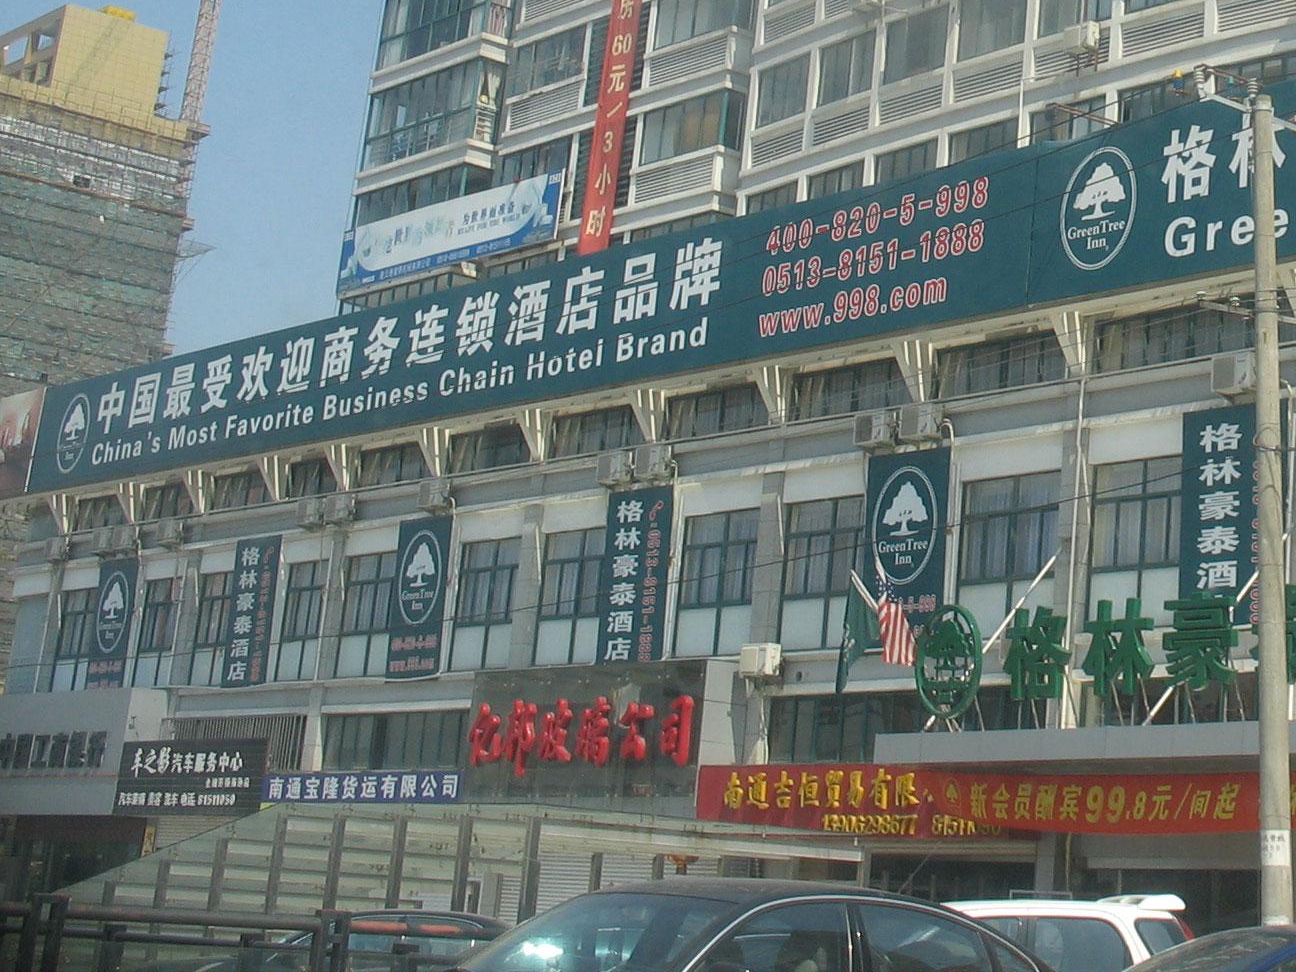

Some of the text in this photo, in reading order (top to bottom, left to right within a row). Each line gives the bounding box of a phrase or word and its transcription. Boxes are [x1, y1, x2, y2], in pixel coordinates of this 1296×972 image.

[765, 175, 989, 255] 400-820-5-998
[1066, 218, 1125, 241] GreenTree
[1086, 235, 1107, 250] Inn
[761, 218, 985, 297] 0513-8151-1888
[96, 236, 723, 435] 中国最受欢迎商务连锁酒店品牌
[758, 276, 947, 338] www.998.com
[168, 419, 222, 452] Most
[225, 404, 314, 440] Favorite
[323, 380, 429, 420] Business
[439, 359, 515, 396] Chain
[616, 317, 708, 364] Brand
[1196, 422, 1243, 599] 格林豪泰酒
[878, 537, 929, 554] GreenTree
[895, 552, 912, 565] Inn
[603, 499, 645, 662] 格林豪泰酒店
[226, 546, 261, 682] 格林豪泰酒店
[268, 774, 459, 800] 南通宝隆货运有限公司
[724, 768, 934, 810] 南通吉恒贸易有限
[969, 781, 1241, 825] 新会员酬宾99.8元/间起
